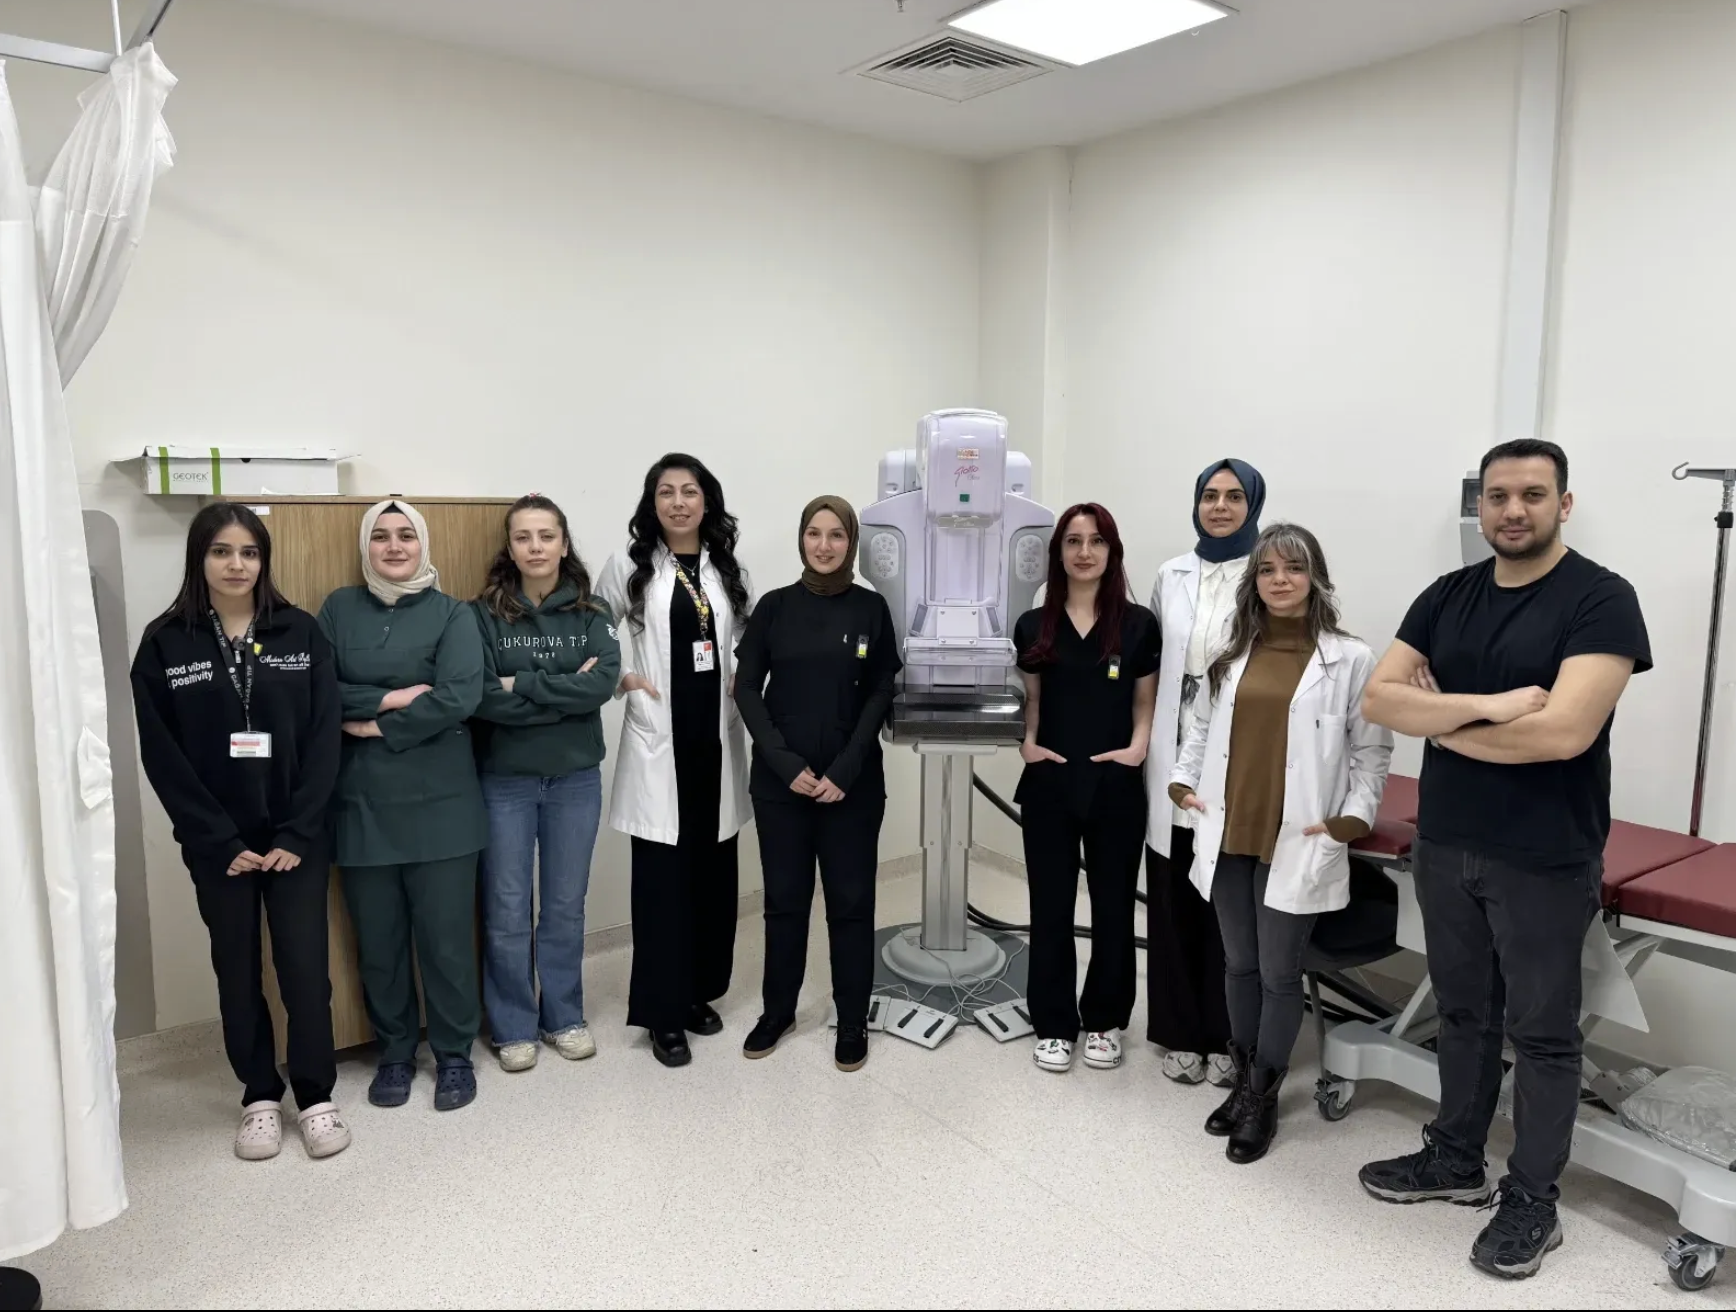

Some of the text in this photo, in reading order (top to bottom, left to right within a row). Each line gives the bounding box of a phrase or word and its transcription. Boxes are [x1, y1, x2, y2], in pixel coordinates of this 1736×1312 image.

[173, 472, 208, 481] GEOTEK
[187, 660, 212, 673] vibes
[171, 670, 213, 690] positivity
